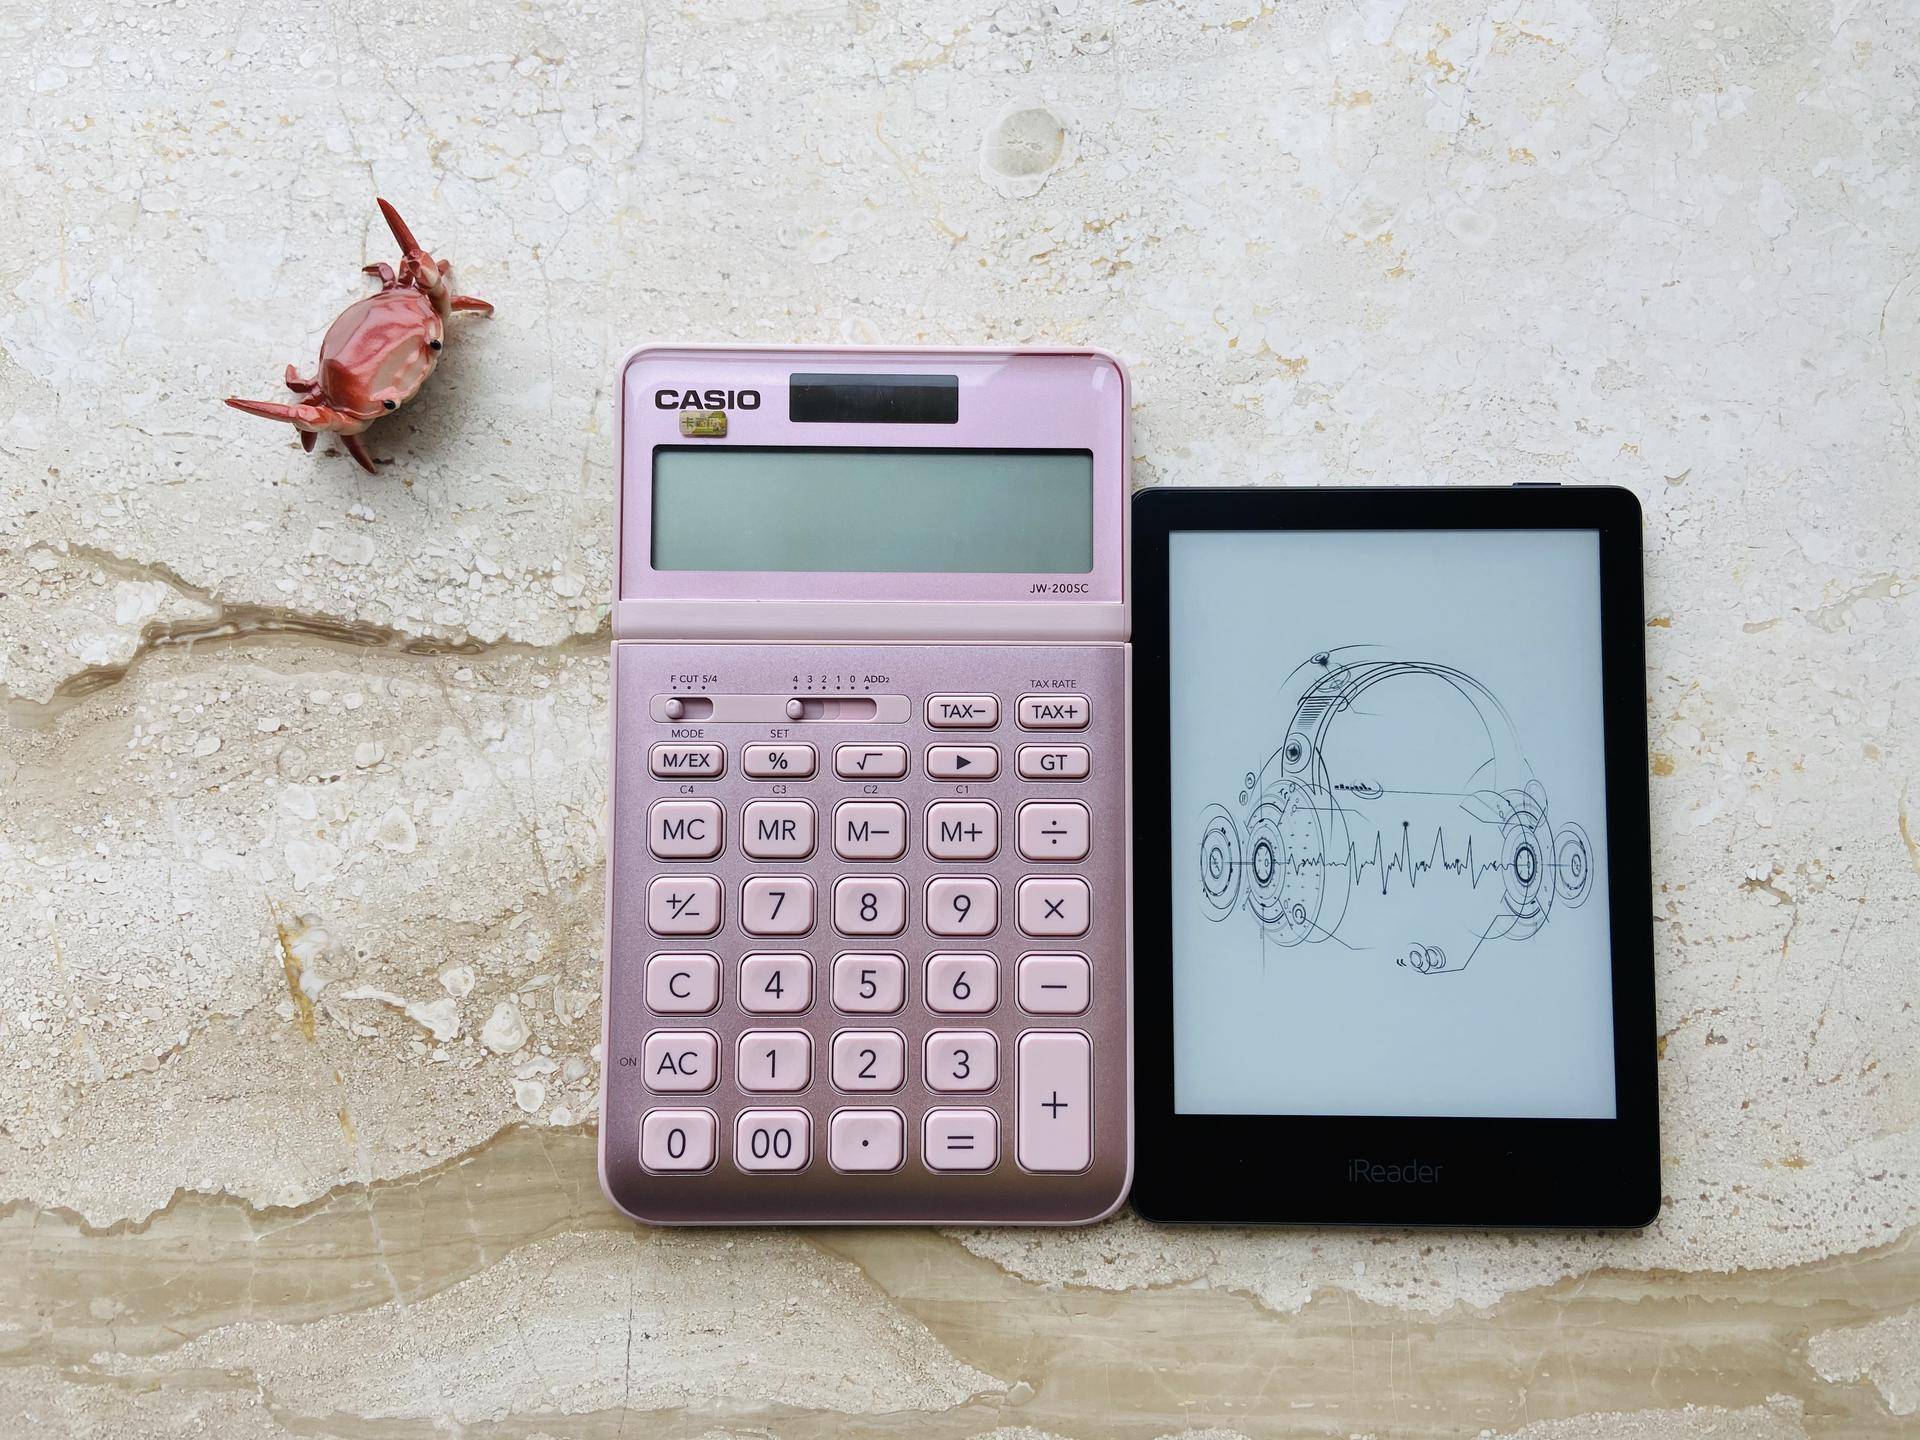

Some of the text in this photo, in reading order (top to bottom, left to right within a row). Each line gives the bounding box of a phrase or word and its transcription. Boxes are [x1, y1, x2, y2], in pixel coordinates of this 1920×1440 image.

[655, 390, 761, 409] CASIO
[1030, 584, 1088, 593] JW-200SC
[680, 675, 698, 683] CUT
[808, 675, 812, 683] 3
[822, 675, 826, 683] 2
[850, 675, 855, 683] 0
[1030, 680, 1076, 688] TAX RATE
[1032, 705, 1077, 718] TAX+
[672, 729, 703, 738] MODE
[771, 729, 789, 738] SET
[664, 754, 709, 767] M/EX
[769, 753, 787, 769] %
[1041, 755, 1067, 770] GT
[680, 786, 693, 794] C4
[772, 785, 786, 794] C3
[864, 785, 877, 794] C2
[956, 785, 969, 794] C1
[664, 819, 704, 840] MC
[759, 820, 795, 840] MR
[942, 822, 982, 842] M+
[769, 892, 785, 919] 7
[860, 893, 877, 921] 8
[954, 895, 971, 922] 9
[670, 973, 690, 998] C
[765, 971, 783, 999] 4
[860, 970, 876, 998] 5
[953, 971, 970, 999] 6
[620, 1057, 636, 1066] ON
[657, 1052, 697, 1075] AC
[766, 1050, 775, 1078] 1
[859, 1050, 876, 1078] 2
[953, 1050, 969, 1079] 3
[668, 1129, 686, 1158] 0
[752, 1129, 791, 1158] 00
[1348, 1158, 1445, 1183] iReader
